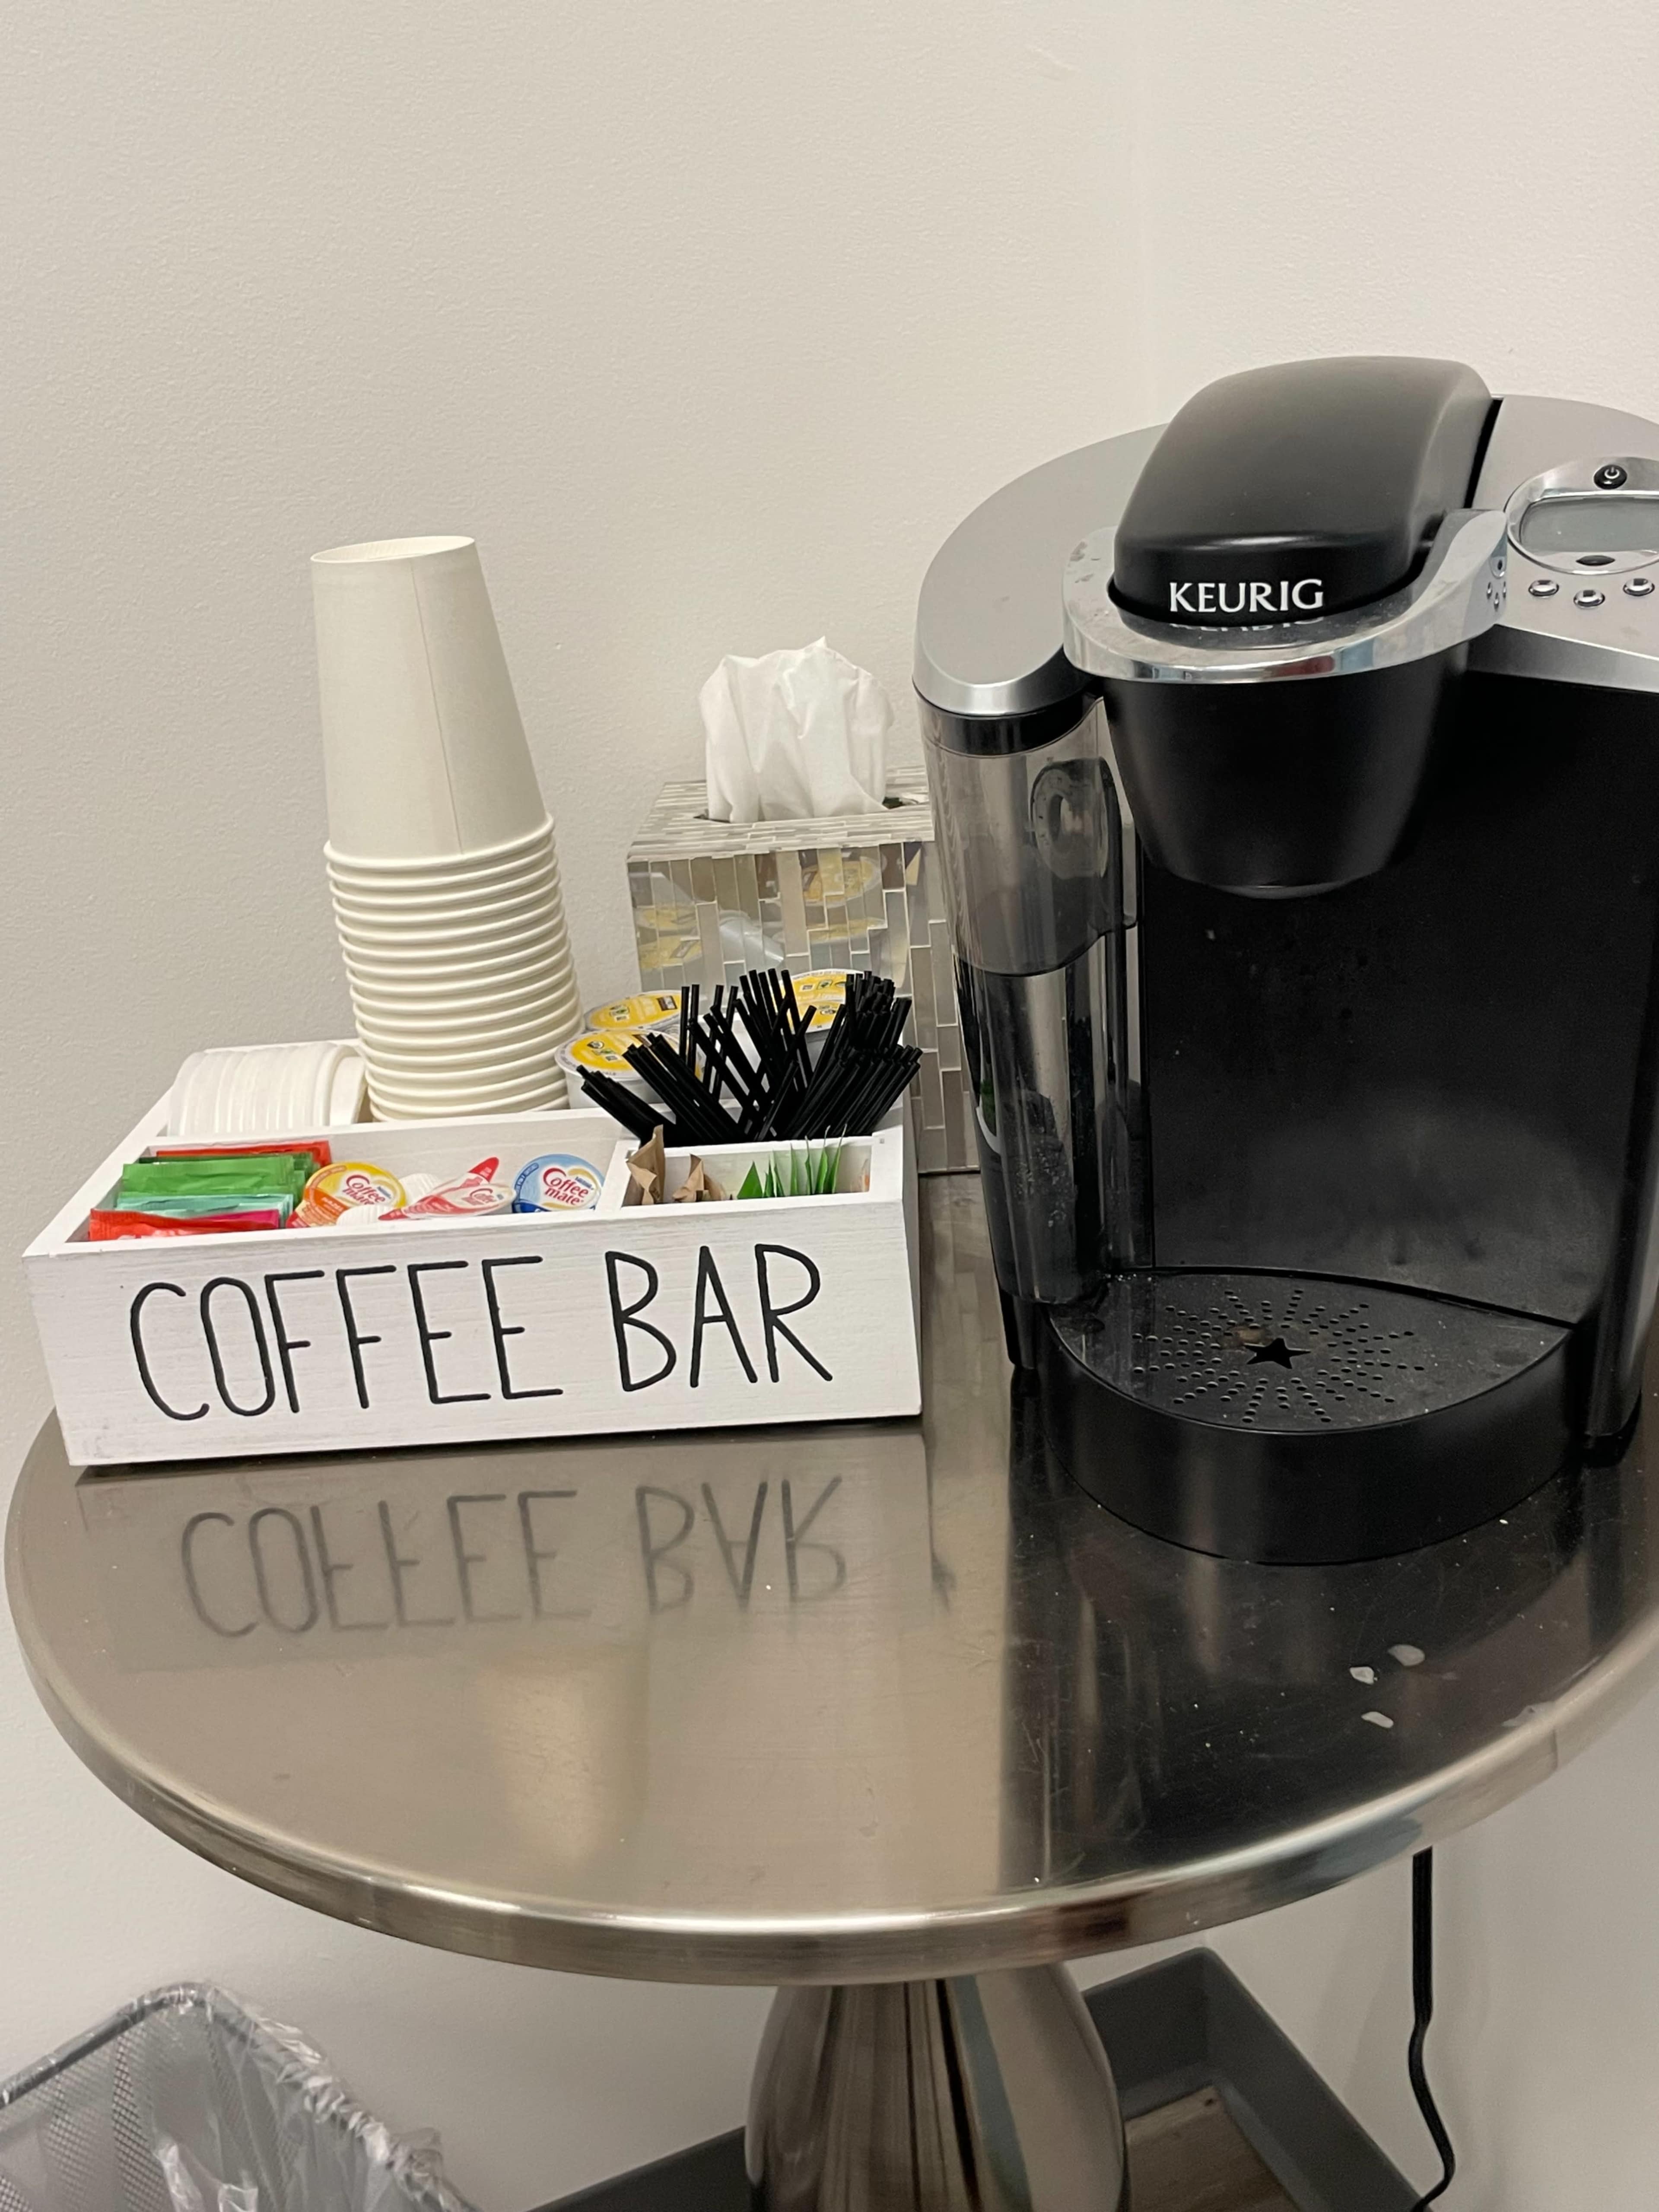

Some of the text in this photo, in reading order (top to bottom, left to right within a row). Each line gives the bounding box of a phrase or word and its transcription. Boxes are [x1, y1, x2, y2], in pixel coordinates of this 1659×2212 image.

[1169, 578, 1324, 613] KEURIG
[346, 1174, 386, 1203] Coffee
[543, 1167, 589, 1198] Coffee
[544, 1188, 582, 1206] mate
[130, 1243, 833, 1421] COFFEE BAR
